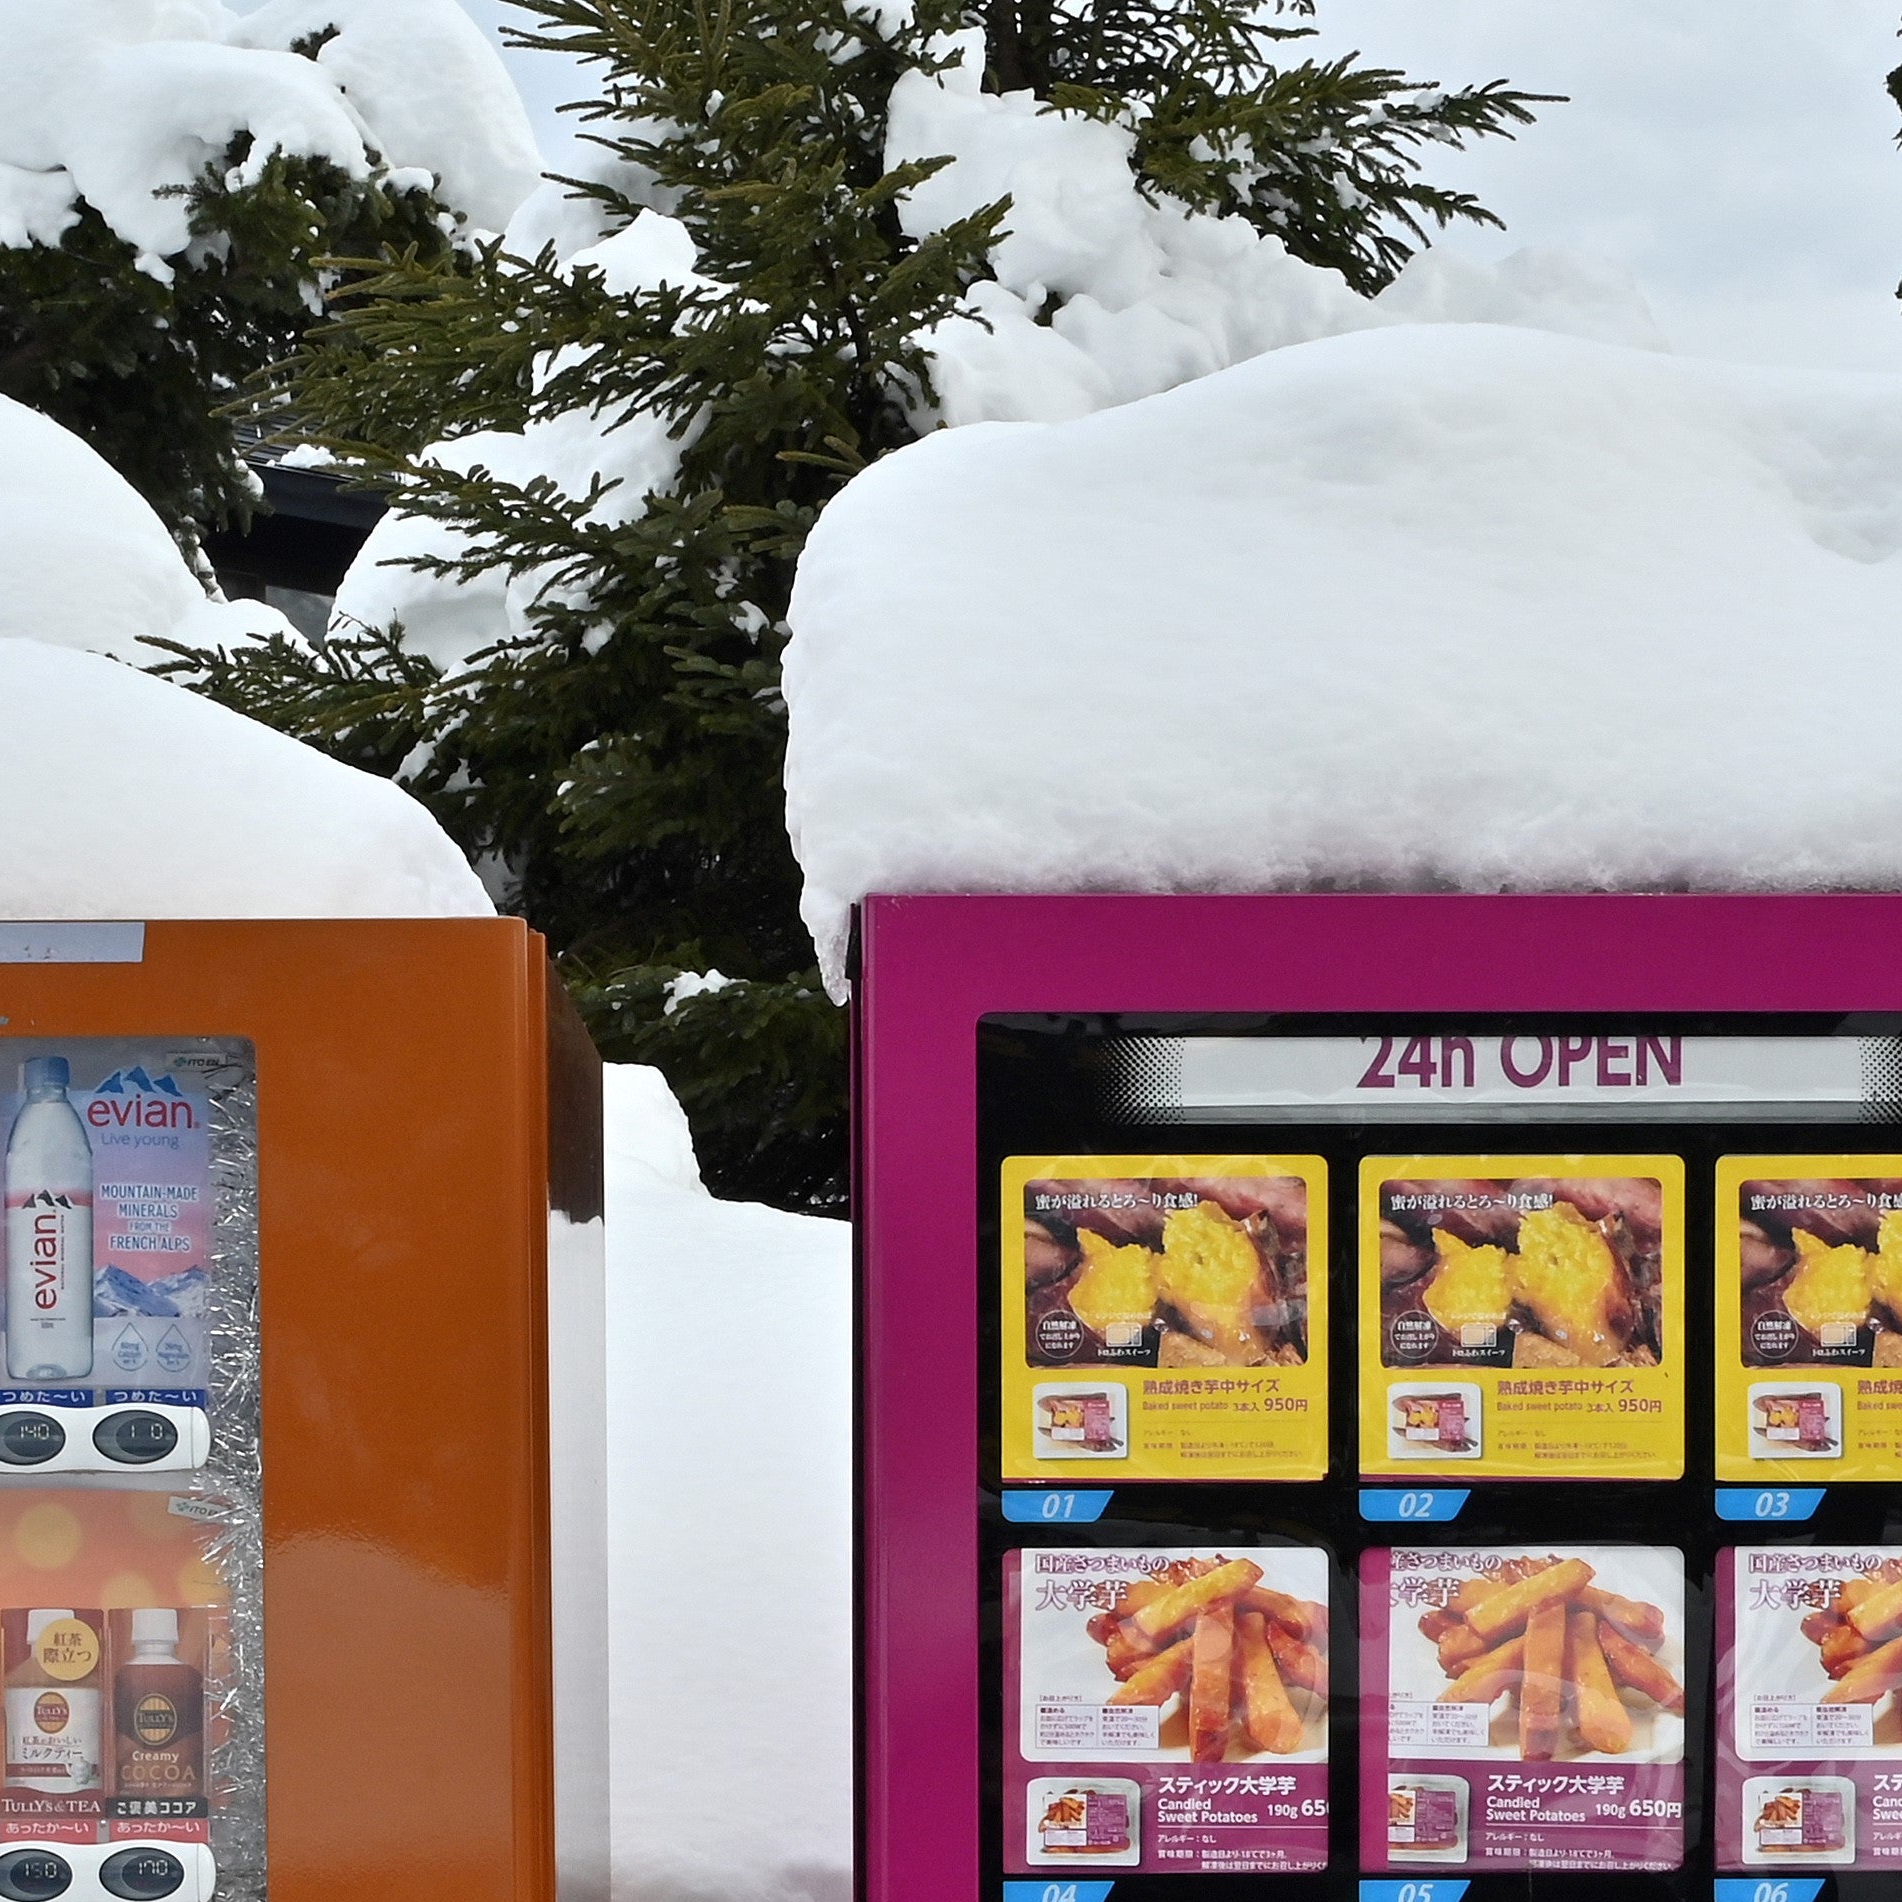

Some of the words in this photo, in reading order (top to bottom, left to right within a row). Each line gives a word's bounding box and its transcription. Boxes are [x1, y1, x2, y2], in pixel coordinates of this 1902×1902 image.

[1356, 1036, 1476, 1088] 24h
[1500, 1035, 1683, 1087] OPEN
[88, 1094, 194, 1128] evian
[101, 1132, 128, 1146] Live
[133, 1134, 179, 1149] young
[101, 1184, 198, 1200] MOUNTAIN-MADE
[118, 1203, 179, 1219] MINERALS
[110, 1236, 157, 1251] FRENCH
[160, 1236, 191, 1251] ALPS
[1264, 1398, 1308, 1412] 950円
[1619, 1398, 1661, 1413] 950円
[1042, 1494, 1075, 1519] 01
[1400, 1493, 1434, 1517] 02
[1755, 1492, 1789, 1517] 03
[1035, 1553, 1169, 1573] 国産さつまいもの
[1036, 1580, 1127, 1611] 大学芋
[54, 1633, 82, 1646] 紅茶
[43, 1647, 92, 1664] 際立つ
[132, 1751, 180, 1763] Creamy
[121, 1765, 197, 1782] COCOA
[1159, 1776, 1296, 1796] スティック大学芋
[117, 1801, 197, 1816] ご褒美ココア
[1158, 1798, 1211, 1811] Candied
[1486, 1796, 1540, 1808] Candied
[1595, 1804, 1626, 1819] 190g
[1629, 1800, 1682, 1818] 650円
[1158, 1811, 1198, 1823] Sweet
[1202, 1811, 1258, 1823] Potatoes
[1267, 1804, 1298, 1818] 190g
[1486, 1809, 1526, 1822] Sweet
[1530, 1809, 1585, 1822] Potatoes
